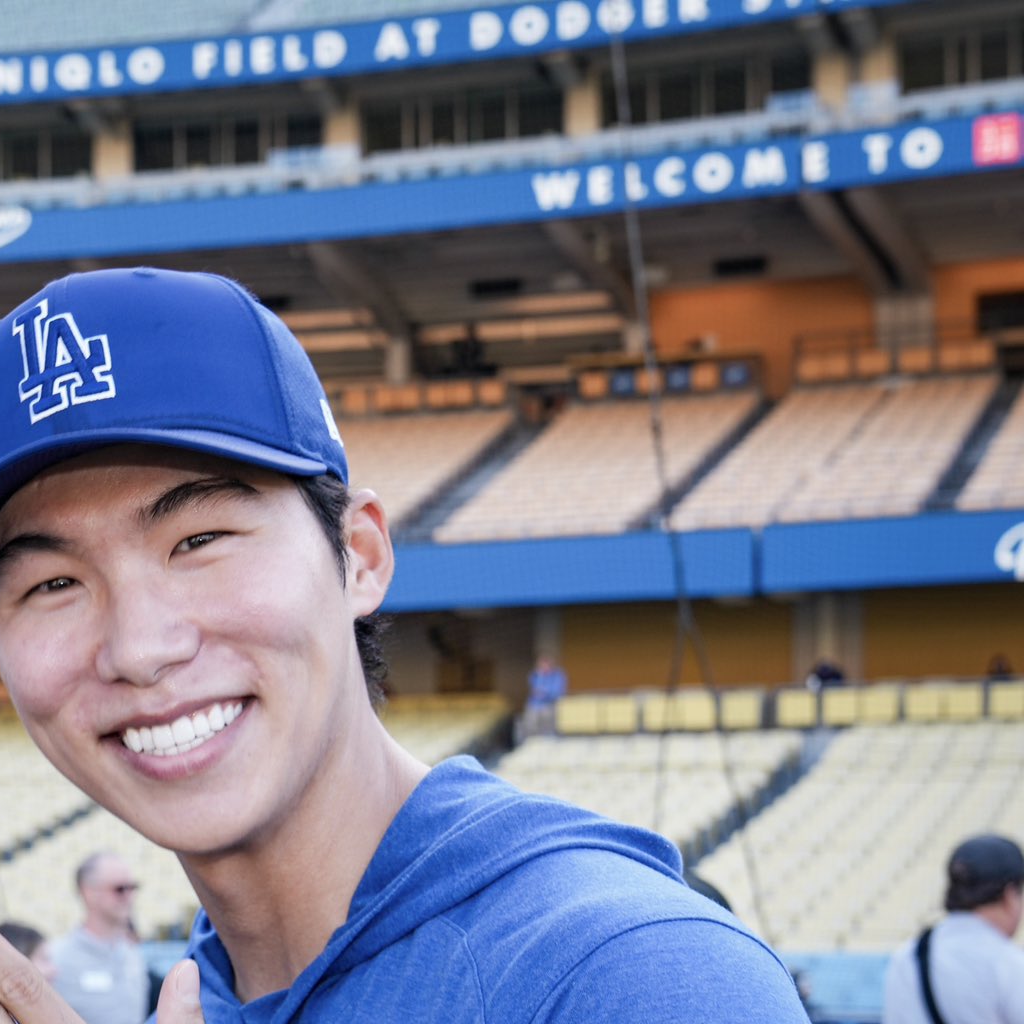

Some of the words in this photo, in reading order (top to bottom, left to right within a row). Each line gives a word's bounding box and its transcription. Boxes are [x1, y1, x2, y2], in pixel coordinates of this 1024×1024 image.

[192, 30, 347, 79] FIELD
[374, 20, 441, 62] AT
[531, 143, 830, 211] WELCOME
[862, 126, 944, 174] TO
[12, 299, 116, 424] LA
